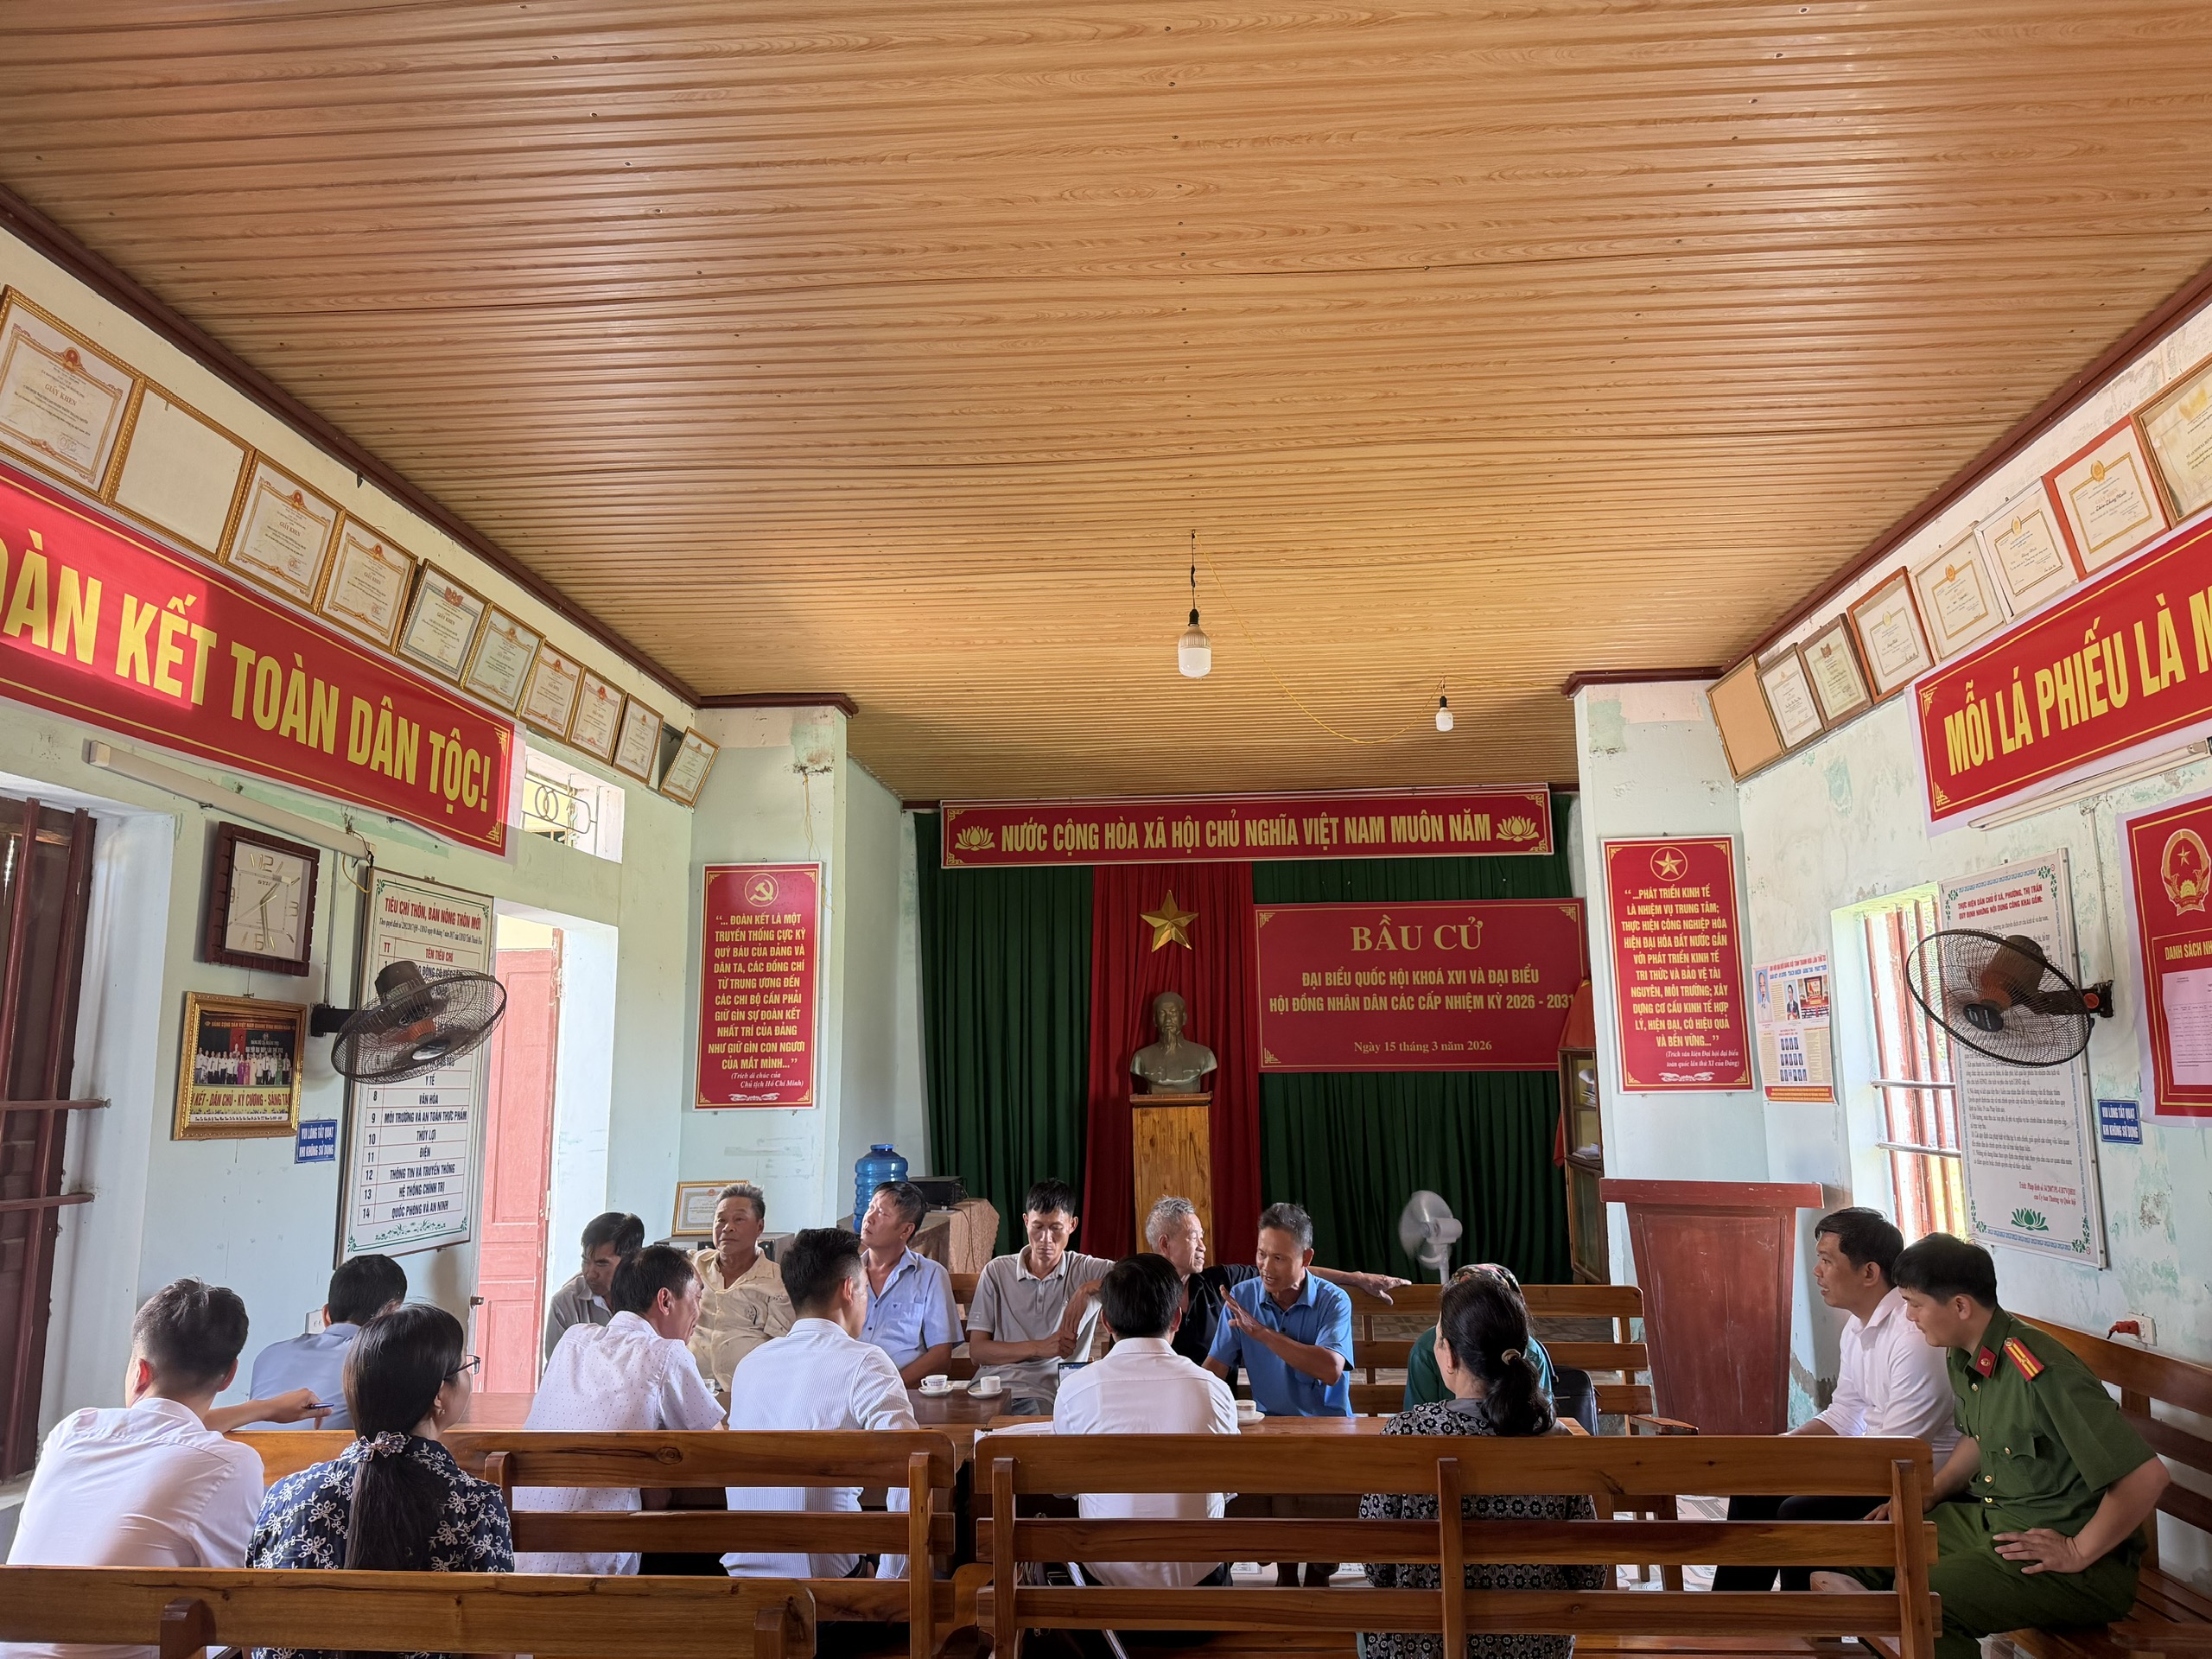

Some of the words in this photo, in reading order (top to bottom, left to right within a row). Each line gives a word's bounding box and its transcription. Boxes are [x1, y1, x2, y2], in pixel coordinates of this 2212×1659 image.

[1944, 679, 1993, 776] MỖI
[1996, 666, 2033, 754] LÁ
[2035, 617, 2128, 738] PHIẾU
[2134, 593, 2186, 697] LÀ
[115, 594, 216, 705] KẾT
[232, 640, 340, 754] TOÀN
[347, 696, 419, 785] DÂN
[429, 728, 490, 814] TỘC!
[1002, 817, 1047, 852] NƯỚC
[1053, 818, 1099, 856] CỘNG
[1105, 816, 1139, 849] HÒA
[1144, 817, 1166, 849] XÃ
[1172, 816, 1199, 854] HỘI
[1206, 809, 1239, 847] CHỦ
[1245, 814, 1298, 846] NGHĨA
[1303, 812, 1339, 850] VIỆT
[1344, 816, 1385, 843] NAM
[1390, 809, 1444, 842] MUÔN
[1449, 809, 1491, 842] NĂM
[1659, 884, 1681, 898] TRIỂN
[1682, 887, 1700, 898] KINH
[1701, 883, 1710, 897] TẾ
[385, 896, 397, 913] TIÊU
[399, 899, 410, 915] CHÍ
[411, 902, 427, 921] THÔN,
[429, 903, 440, 921] BẢN
[441, 908, 455, 925] NÔNG
[457, 912, 470, 928] THÔN
[471, 914, 481, 930] MỚI
[1627, 903, 1637, 915] LÀ
[1638, 903, 1662, 917] NHIỆM
[1663, 904, 1673, 916] VỤ
[1675, 903, 1699, 914] TRUNG
[1700, 901, 1719, 913] TÂM;
[730, 913, 753, 925] ĐOÀN
[755, 912, 769, 924] KẾT
[772, 912, 781, 924] LÀ
[784, 912, 801, 925] MỘT
[715, 927, 746, 942] TRUYỀN
[748, 927, 774, 941] THỐNG
[777, 929, 792, 943] CỰC
[795, 927, 805, 940] KỲ
[1351, 914, 1422, 951] BẦU
[1433, 917, 1484, 950] CỬ
[385, 942, 391, 952] TT
[435, 949, 445, 961] TIÊU
[715, 945, 730, 958] QUÝ
[733, 945, 749, 957] BÁU
[752, 943, 767, 956] CỦA
[770, 943, 791, 956] ĐẢNG
[795, 944, 804, 956] VÀ
[1633, 951, 1646, 964] VỚI
[1648, 952, 1666, 963] PHÁT
[1668, 950, 1689, 963] TRIỂN
[1691, 953, 1709, 963] KINH
[1711, 949, 1719, 963] TẾ
[2164, 945, 2183, 960] DANH
[2183, 941, 2202, 957] SÁCH
[714, 962, 730, 973] DÂN
[734, 963, 745, 974] TA,
[747, 961, 764, 972] CÁC
[766, 959, 788, 972] ĐỒNG
[791, 959, 804, 971] CHÍ
[718, 976, 728, 989] TỪ
[730, 978, 756, 988] TRUNG
[760, 978, 781, 988] ƯƠNG
[784, 974, 800, 987] ĐẾN
[1302, 972, 1322, 989] ĐẠI
[1325, 966, 1351, 986] BIỂU
[1355, 966, 1386, 986] QUỐC
[1389, 968, 1411, 988] HỘI
[1413, 968, 1444, 985] KHOÁ
[1447, 970, 1466, 984] XVI
[1469, 967, 1485, 983] VÀ
[1488, 969, 1509, 987] ĐẠI
[1512, 963, 1539, 983] BIỂU
[715, 994, 731, 1005] CÁC
[734, 995, 747, 1005] CHI
[750, 993, 760, 1007] BỘ
[764, 991, 779, 1004] CẦN
[783, 989, 801, 1003] PHẢI
[1269, 995, 1288, 1014] HỘI
[1292, 993, 1324, 1011] ĐỒNG
[1327, 995, 1360, 1011] NHÂN
[1363, 995, 1388, 1010] DÂN
[1391, 993, 1414, 1010] CÁC
[1418, 991, 1442, 1009] CẤP
[1446, 992, 1484, 1013] NHIỆM
[1488, 992, 1503, 1009] KỲ
[1506, 995, 1535, 1008] 2026
[715, 1009, 729, 1021] GIỮ
[731, 1009, 745, 1020] GÌN
[747, 1010, 760, 1022] SỰ
[761, 1008, 783, 1020] ĐOÀN
[785, 1006, 800, 1019] KẾT
[717, 1024, 739, 1037] NHẤT
[741, 1025, 753, 1036] TRÍ
[756, 1022, 772, 1036] CỦA
[775, 1021, 797, 1035] ĐẢNG
[709, 1042, 726, 1053] NHƯ
[728, 1041, 742, 1053] GIỮ
[744, 1041, 758, 1052] GÌN
[760, 1042, 777, 1052] CON
[1354, 1042, 1381, 1053] Ngày
[1384, 1042, 1396, 1051] 15
[1399, 1041, 1429, 1053] tháng
[1432, 1041, 1438, 1051] 3
[1441, 1041, 1465, 1051] năm
[1467, 1041, 1492, 1051] 2026
[721, 1055, 738, 1070] CỦA
[373, 1091, 377, 1101] 8
[372, 1113, 375, 1123] 9
[369, 1134, 376, 1145] 10
[368, 1153, 374, 1162] 11
[420, 1145, 430, 1159] ĐIỆN
[366, 1170, 372, 1180] 12
[365, 1189, 372, 1199] 13
[363, 1208, 370, 1218] 14
